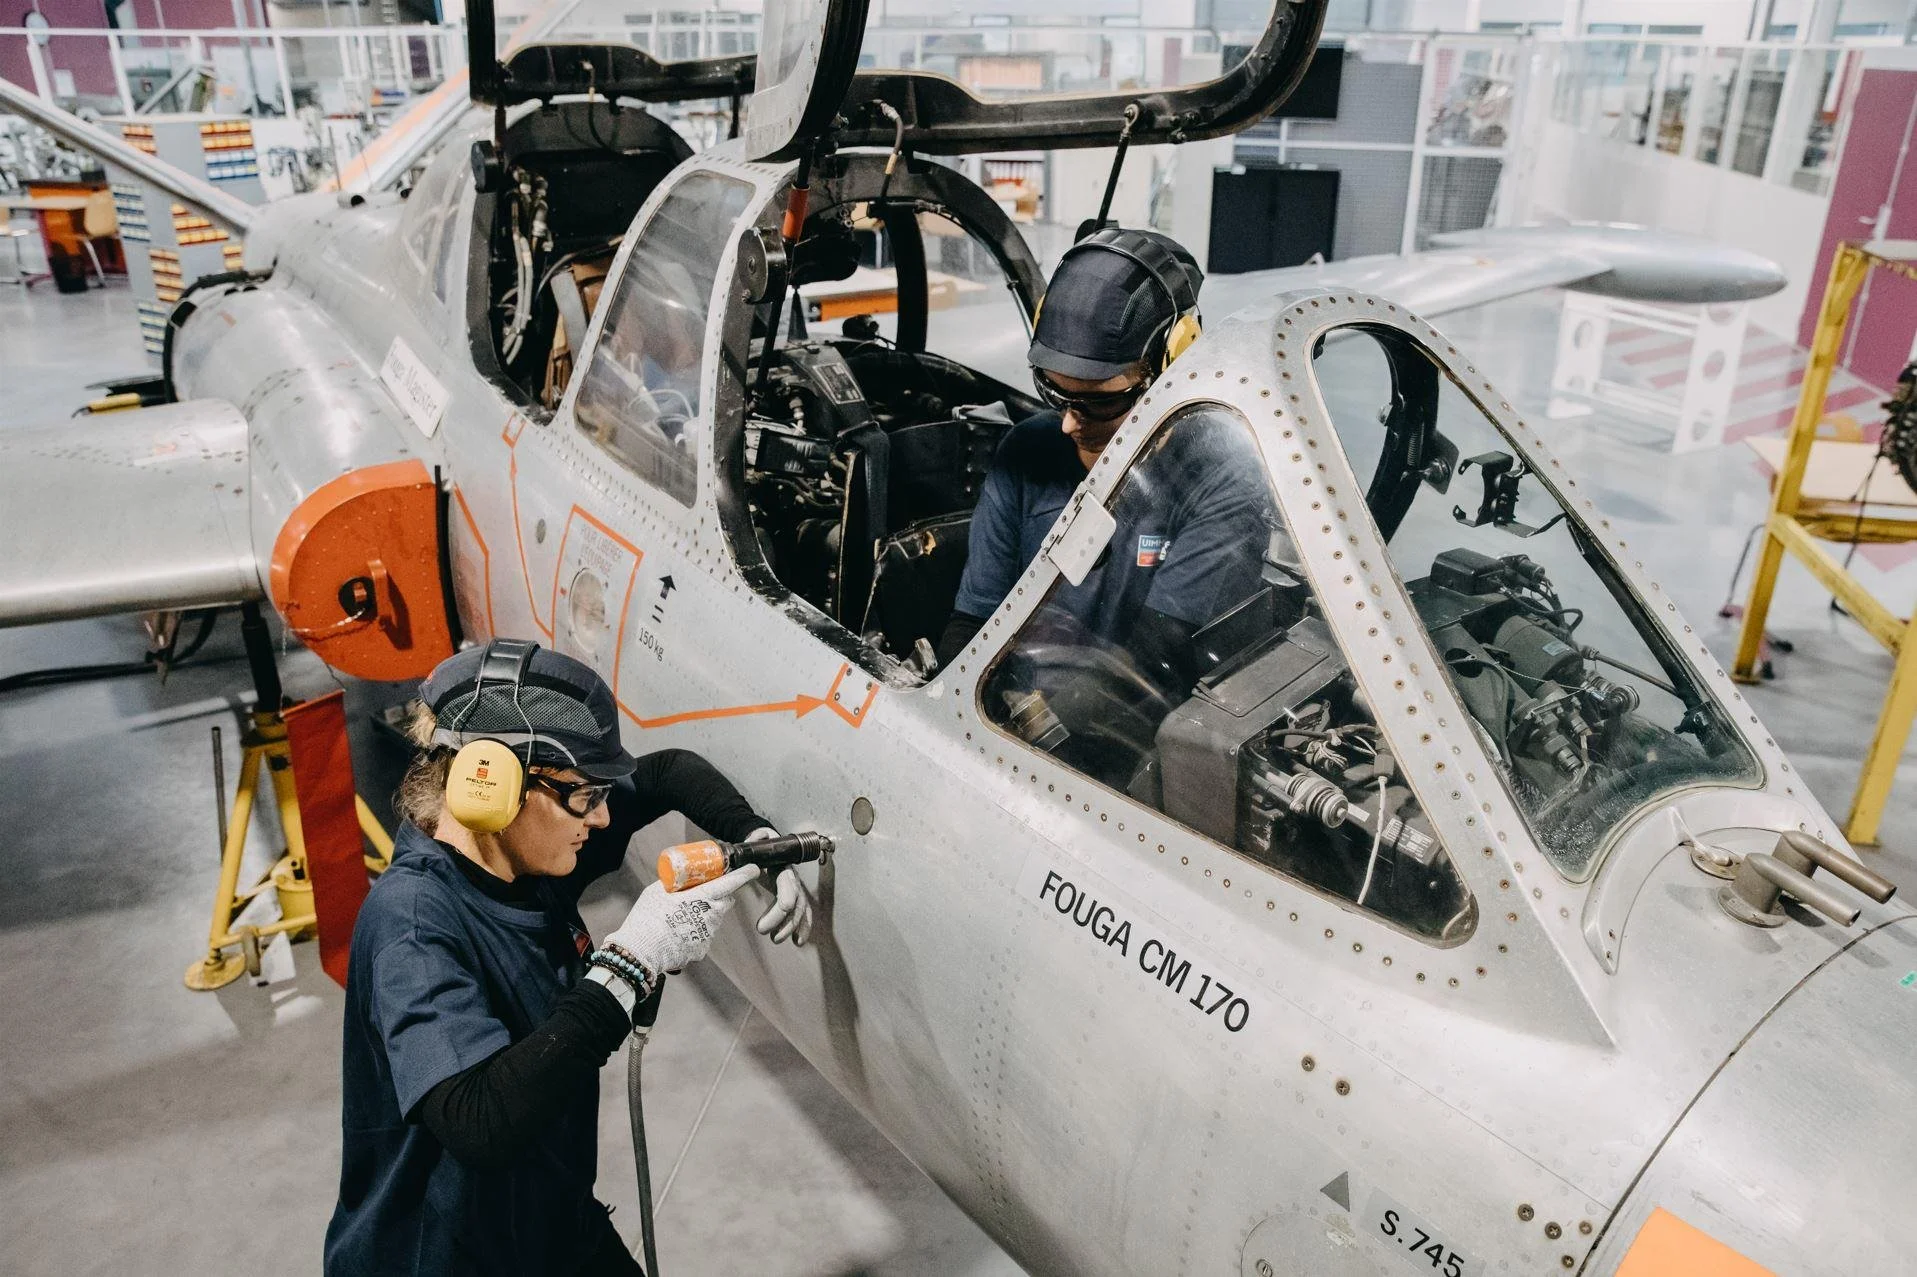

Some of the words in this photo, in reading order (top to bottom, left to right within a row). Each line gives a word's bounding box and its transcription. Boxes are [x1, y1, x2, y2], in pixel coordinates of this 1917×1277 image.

[639, 627, 654, 649] 150
[654, 639, 665, 662] kg
[465, 776, 497, 786] PELTOR
[1039, 870, 1132, 957] FOUGA
[1139, 939, 1192, 994] CM
[1189, 974, 1250, 1033] 170
[1380, 1210, 1465, 1277] S.745
